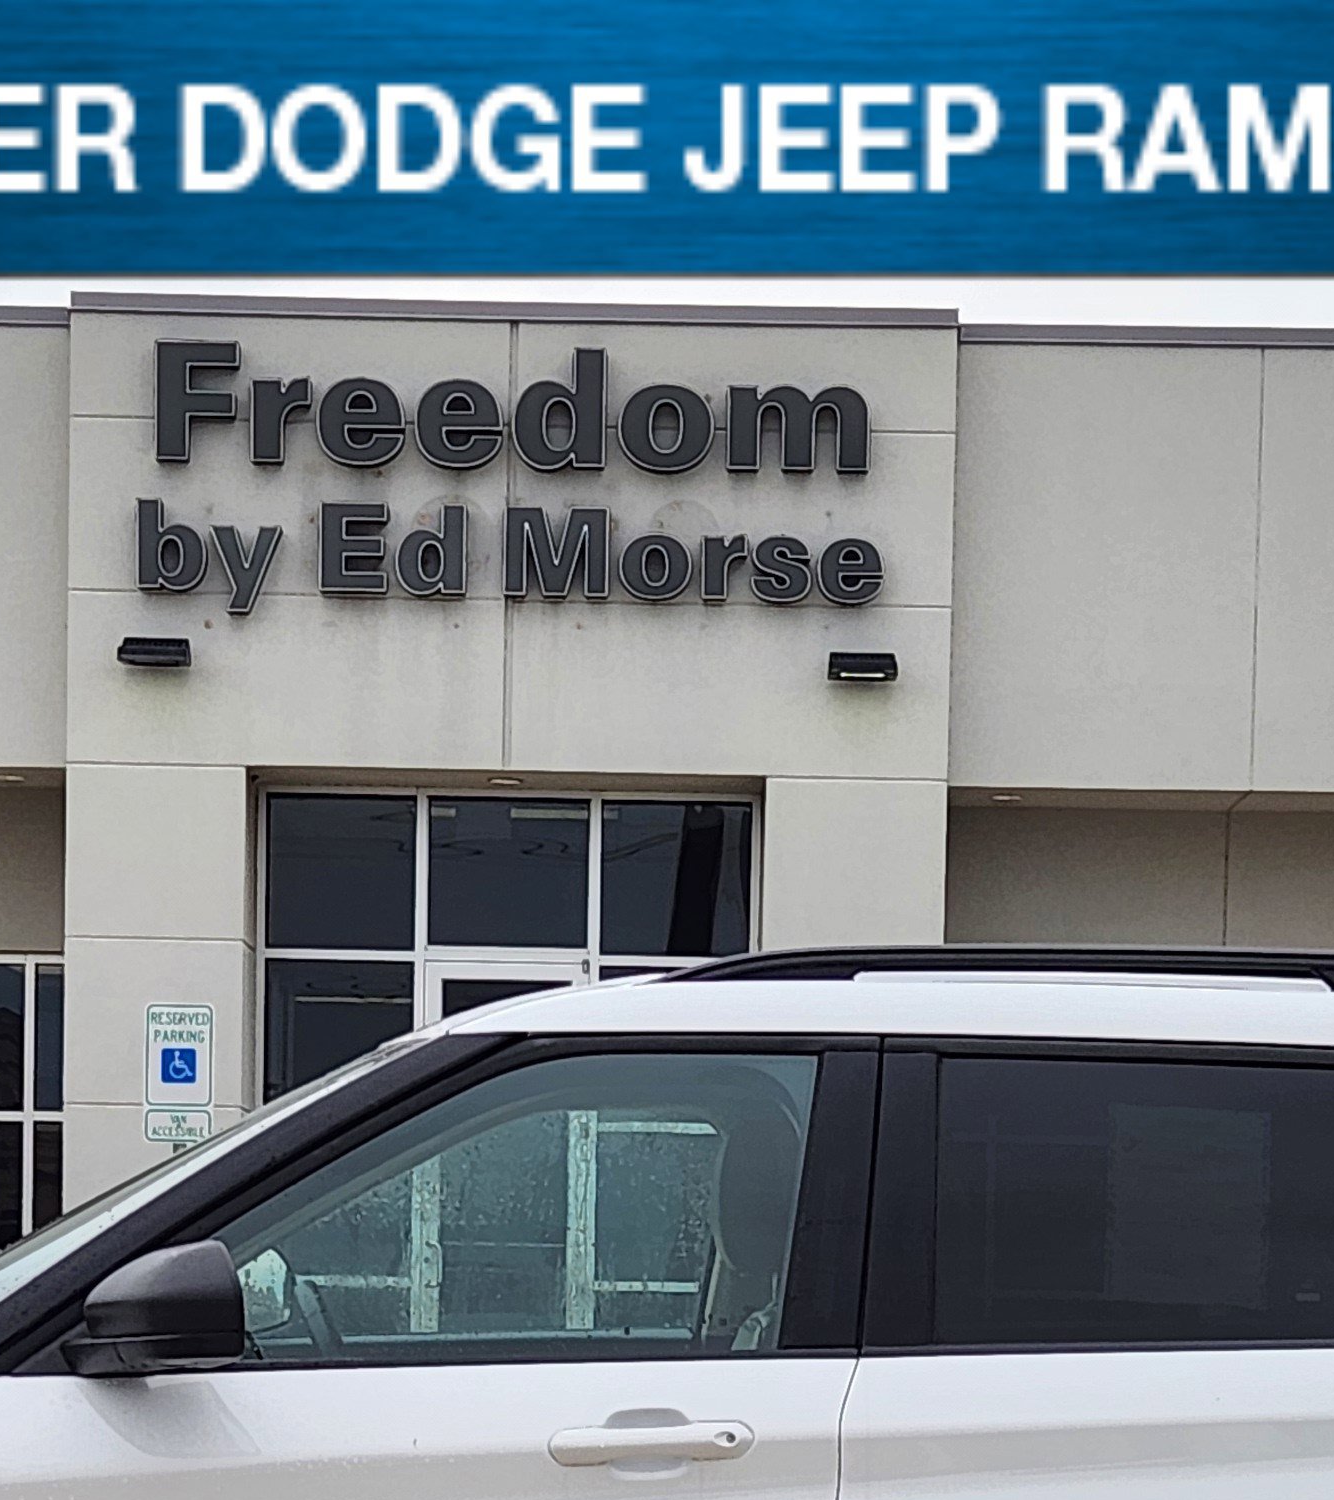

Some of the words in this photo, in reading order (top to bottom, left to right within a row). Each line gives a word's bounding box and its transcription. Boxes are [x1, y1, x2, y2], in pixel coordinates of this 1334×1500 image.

[153, 338, 872, 473] Freedom
[133, 498, 282, 615] by
[318, 500, 466, 599] Ed
[501, 504, 886, 606] Morse
[150, 1011, 210, 1026] RESERVED
[153, 1029, 206, 1044] PARKING
